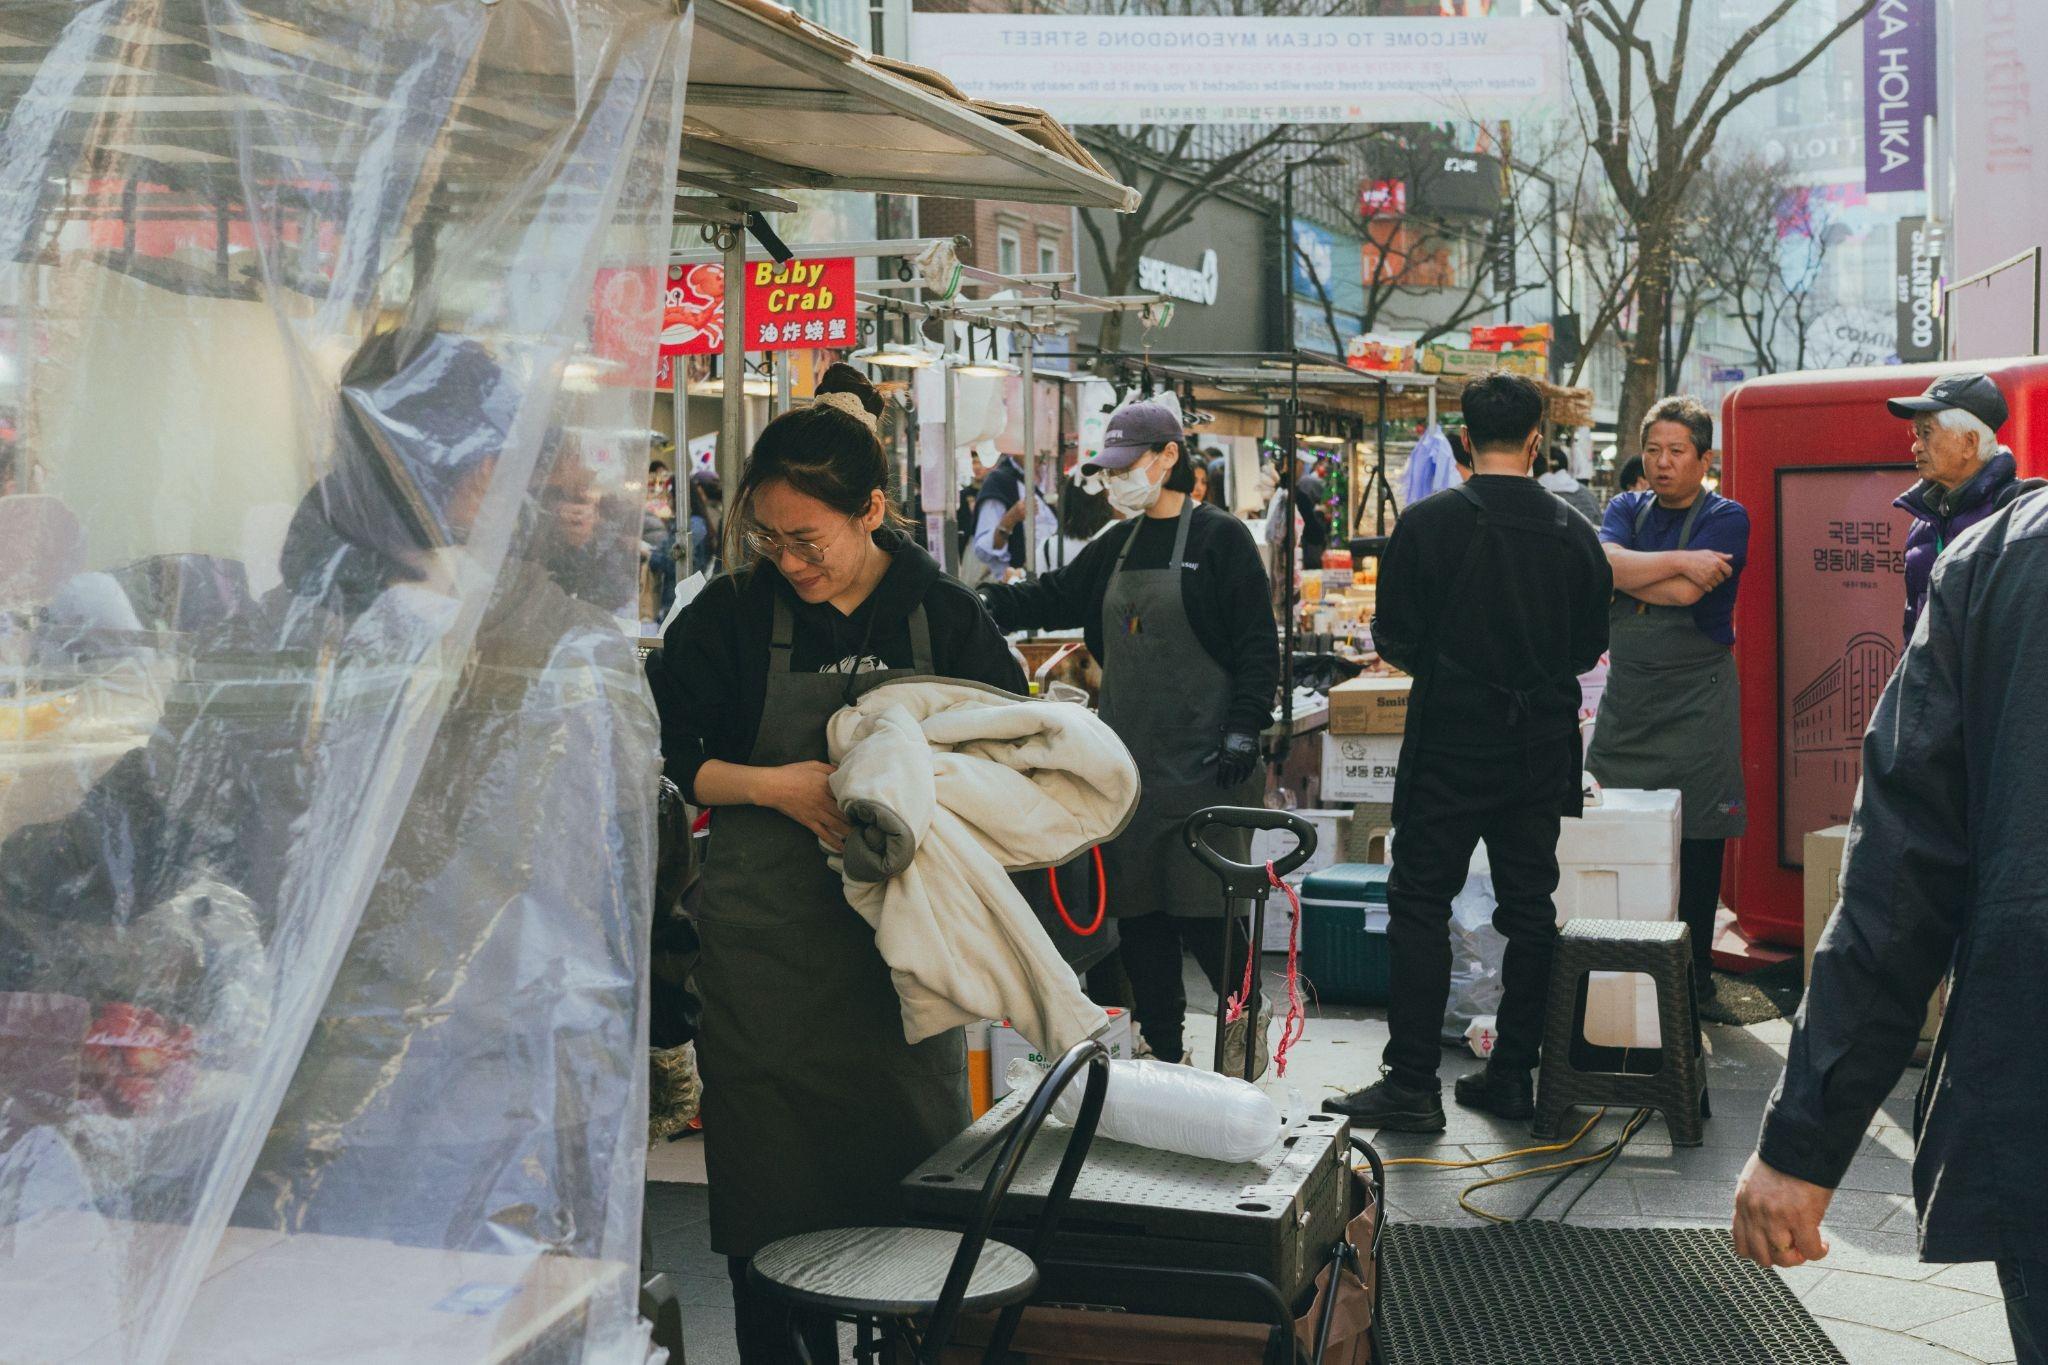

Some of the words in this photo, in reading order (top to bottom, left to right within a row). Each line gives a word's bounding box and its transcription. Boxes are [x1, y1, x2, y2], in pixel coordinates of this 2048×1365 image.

[1878, 48, 1910, 174] HOLIKA
[1793, 137, 1857, 160] LOTT
[755, 261, 825, 287] Baby
[768, 286, 834, 313] Crab
[1911, 230, 1933, 348] SKINFOOD
[759, 318, 847, 343] 油炸螃蟹
[1835, 325, 1898, 349] COMIN
[1828, 521, 1891, 545] 국립극단
[1813, 548, 1906, 574] 명동예술극장
[1345, 765, 1369, 778] 냉동
